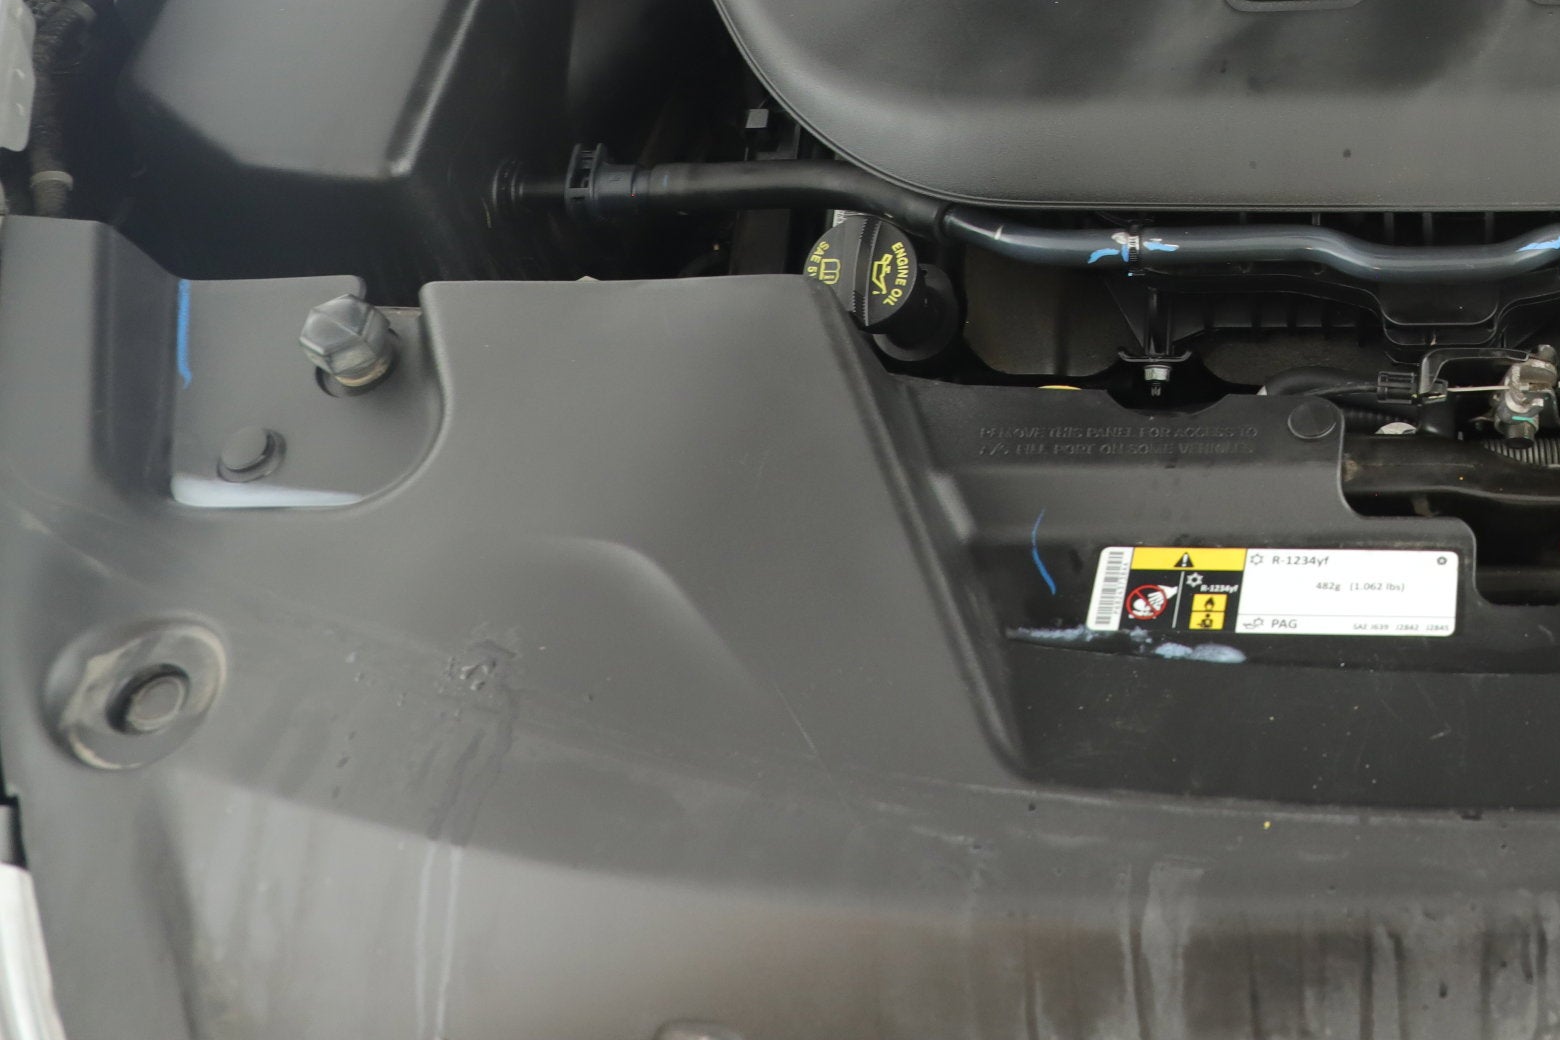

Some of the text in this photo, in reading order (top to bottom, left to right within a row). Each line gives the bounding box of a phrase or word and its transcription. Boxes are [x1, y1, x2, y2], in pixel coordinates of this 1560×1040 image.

[811, 241, 830, 263] SAE
[883, 242, 909, 305] ENGINE OIL
[1138, 426, 1172, 439] FOR
[1272, 556, 1329, 567] R-1234yf
[1201, 585, 1239, 594] R-1234yf
[1316, 582, 1341, 592] 482g
[1272, 620, 1297, 629] PAG
